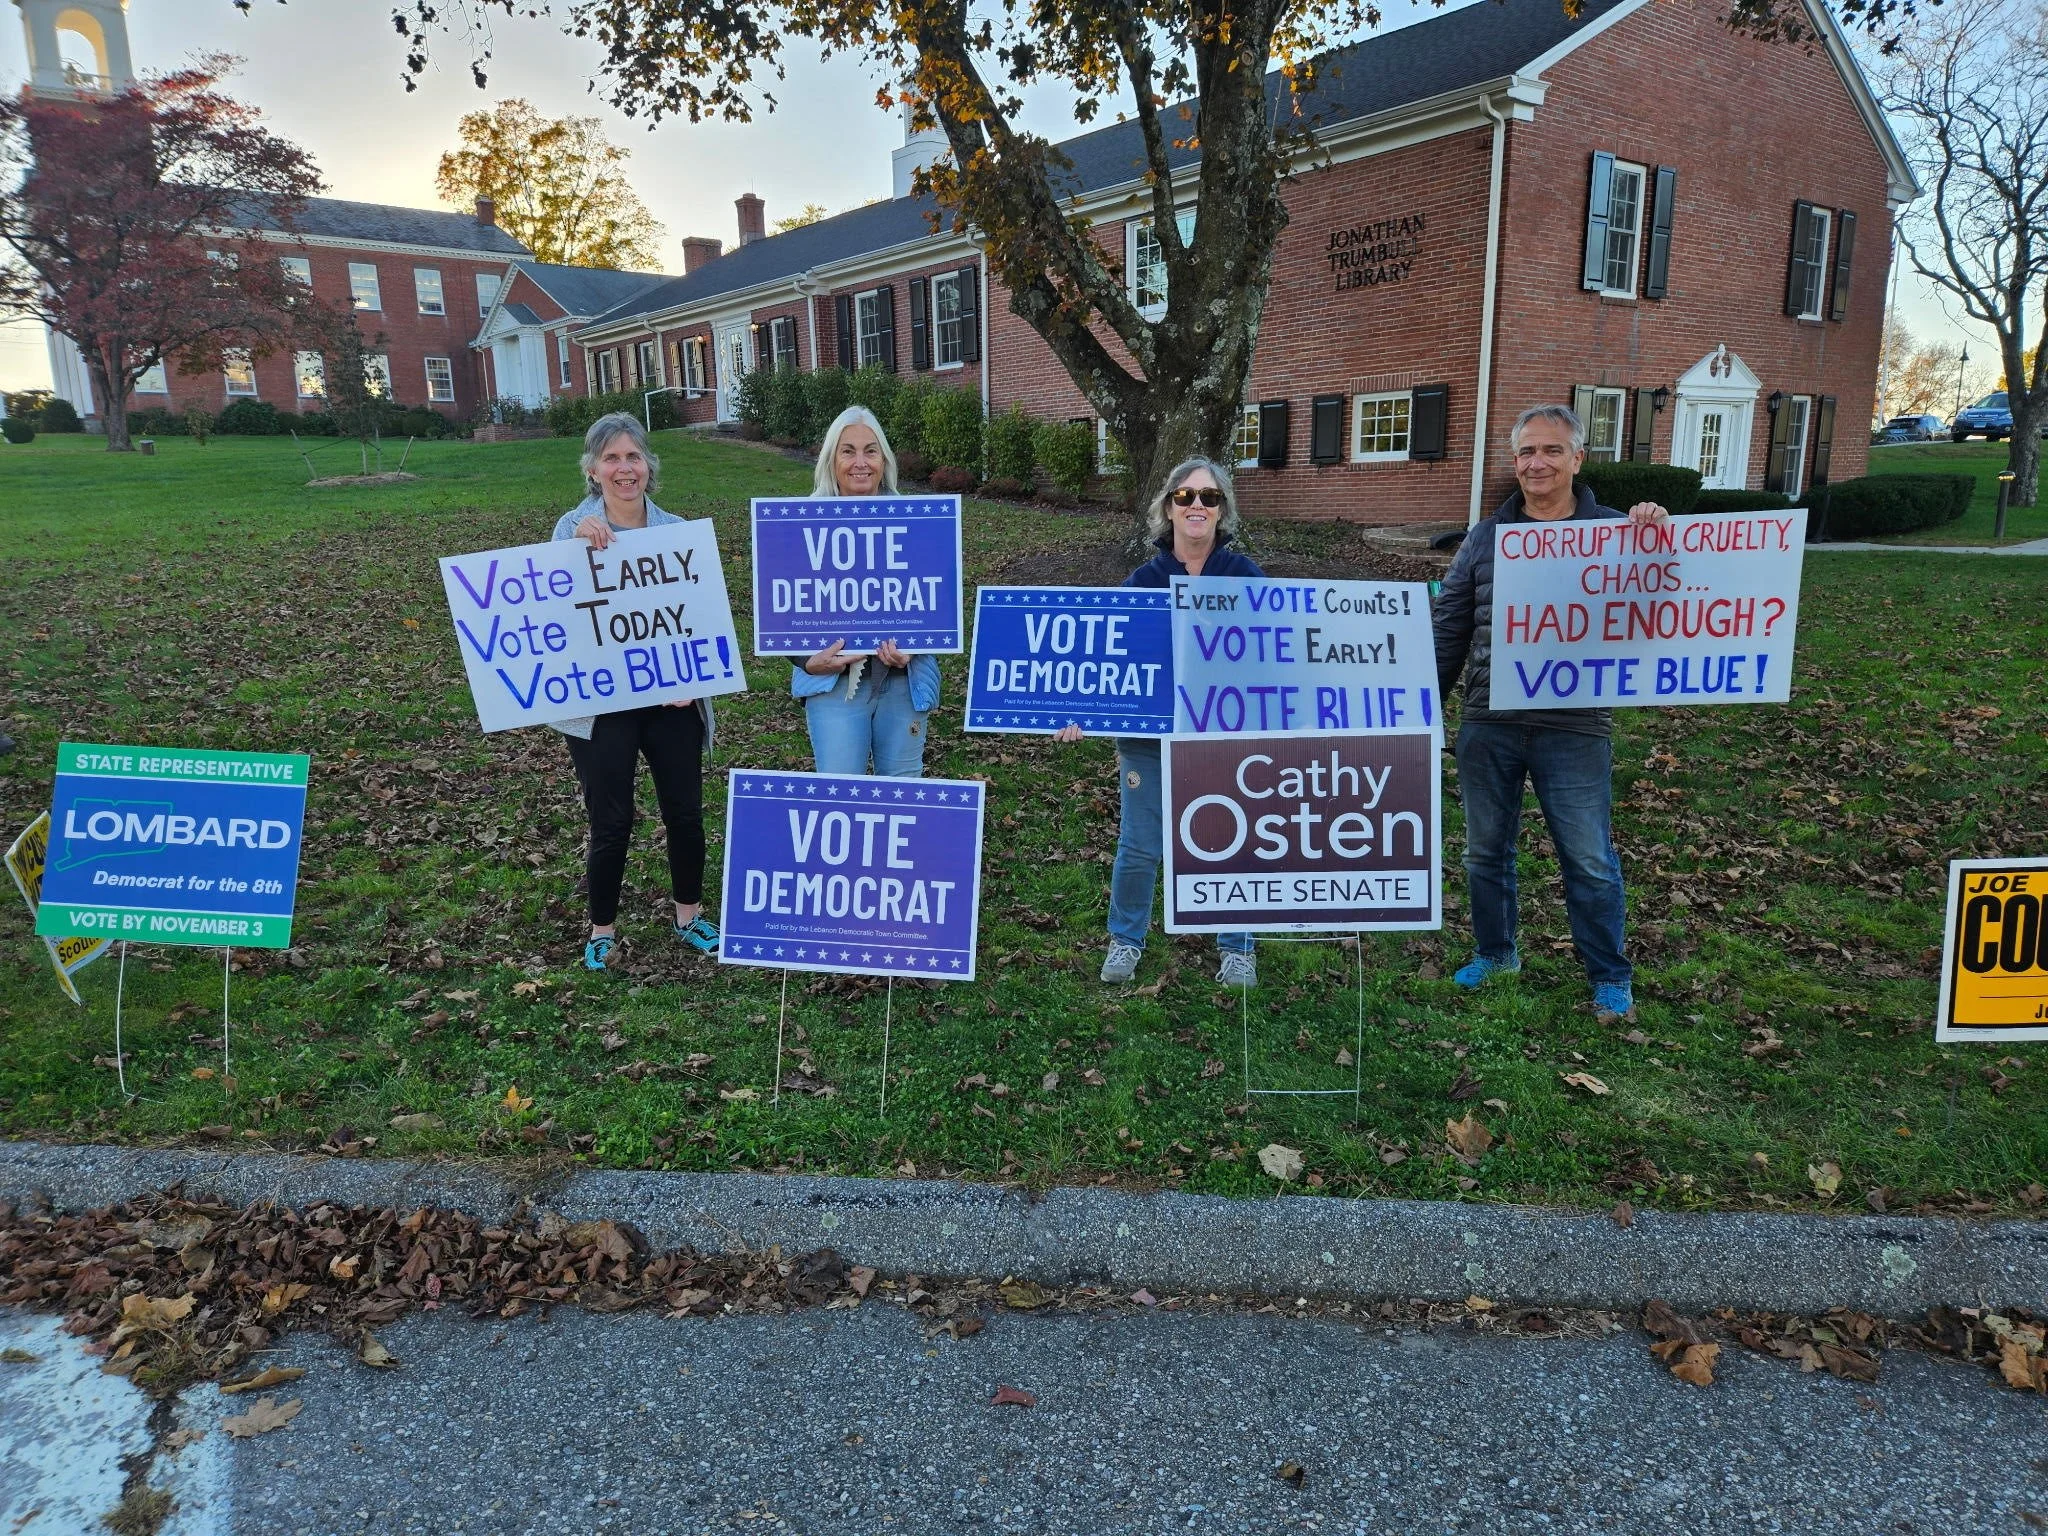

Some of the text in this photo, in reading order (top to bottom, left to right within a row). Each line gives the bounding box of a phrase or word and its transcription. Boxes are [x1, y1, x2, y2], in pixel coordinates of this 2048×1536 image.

[1326, 213, 1425, 250] JONATHAN
[1328, 237, 1423, 271] TRUMBULL
[1336, 260, 1411, 291] LIBRARY
[803, 526, 908, 570] VOTE
[1501, 518, 1793, 560] CORRUPTION, CRUELTY,
[450, 546, 699, 610] Vote EARLY,
[772, 577, 942, 613] DEMOCRAT
[1581, 562, 1709, 595] CHAOS...
[1246, 586, 1318, 613] VOTE
[456, 599, 693, 662] Vote TODAY,
[1025, 613, 1129, 656] VOTE
[1506, 597, 1786, 644] HAD ENOUGH?
[1193, 625, 1295, 663] VOTE
[496, 636, 733, 710] Vote BLUE!
[986, 659, 1162, 697] DEMOCRAT
[1515, 654, 1768, 699] VOTE BLUE!
[1178, 685, 1299, 732] VOTE
[75, 753, 294, 780] STATE REPRESENTATIVE
[1236, 750, 1392, 809] Cathy
[63, 809, 291, 849] LOMBARD
[788, 809, 916, 870] VOTE
[1179, 794, 1424, 862] Osten
[92, 870, 283, 895] Democrat for the 8th
[743, 869, 956, 925] DEMOCRAT
[1193, 878, 1411, 904] STATE SENATE
[1968, 875, 2029, 893] JOE
[69, 911, 263, 936] VOTE BY NOVEMBER 3
[765, 922, 779, 930] Paid
[810, 926, 837, 934] Lebanon
[838, 927, 874, 937] Democratic
